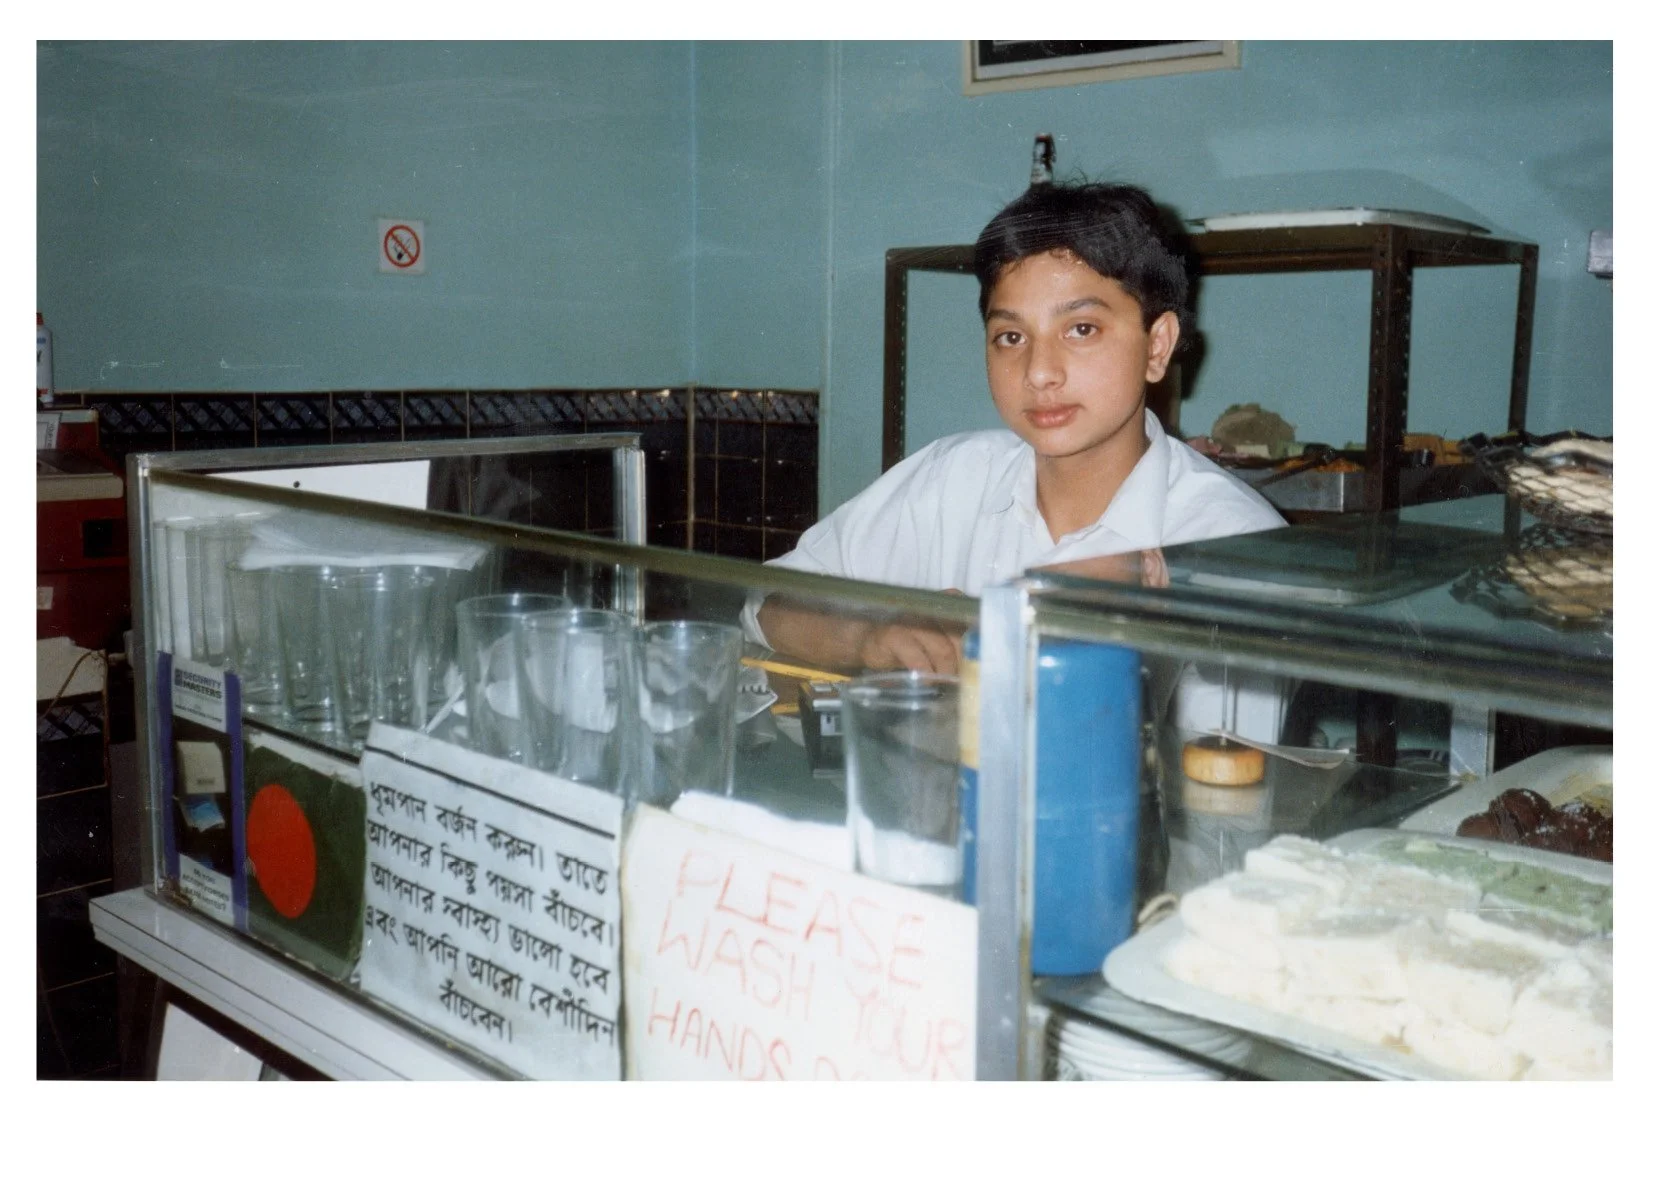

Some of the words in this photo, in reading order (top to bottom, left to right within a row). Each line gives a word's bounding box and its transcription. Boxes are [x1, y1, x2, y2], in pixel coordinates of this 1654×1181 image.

[183, 671, 221, 689] SECURITY
[183, 680, 222, 699] MASTERS
[367, 819, 433, 867] আপনার
[440, 842, 478, 894] কিছু
[370, 781, 427, 822] ধূমপান
[434, 805, 477, 842] বর্জন
[556, 852, 608, 894] তাতে
[365, 905, 398, 945] এবং
[403, 922, 460, 972] আপনি
[466, 952, 523, 1001] আরো
[370, 862, 435, 914] আপনার
[442, 896, 500, 944] স্বাস্থ্য
[508, 924, 563, 972] ভালো
[570, 954, 611, 995] হবে
[677, 850, 925, 988] PLEASE
[647, 986, 792, 1082] HANDS
[658, 900, 815, 1022] WASH
[844, 976, 967, 1082] YOUR
